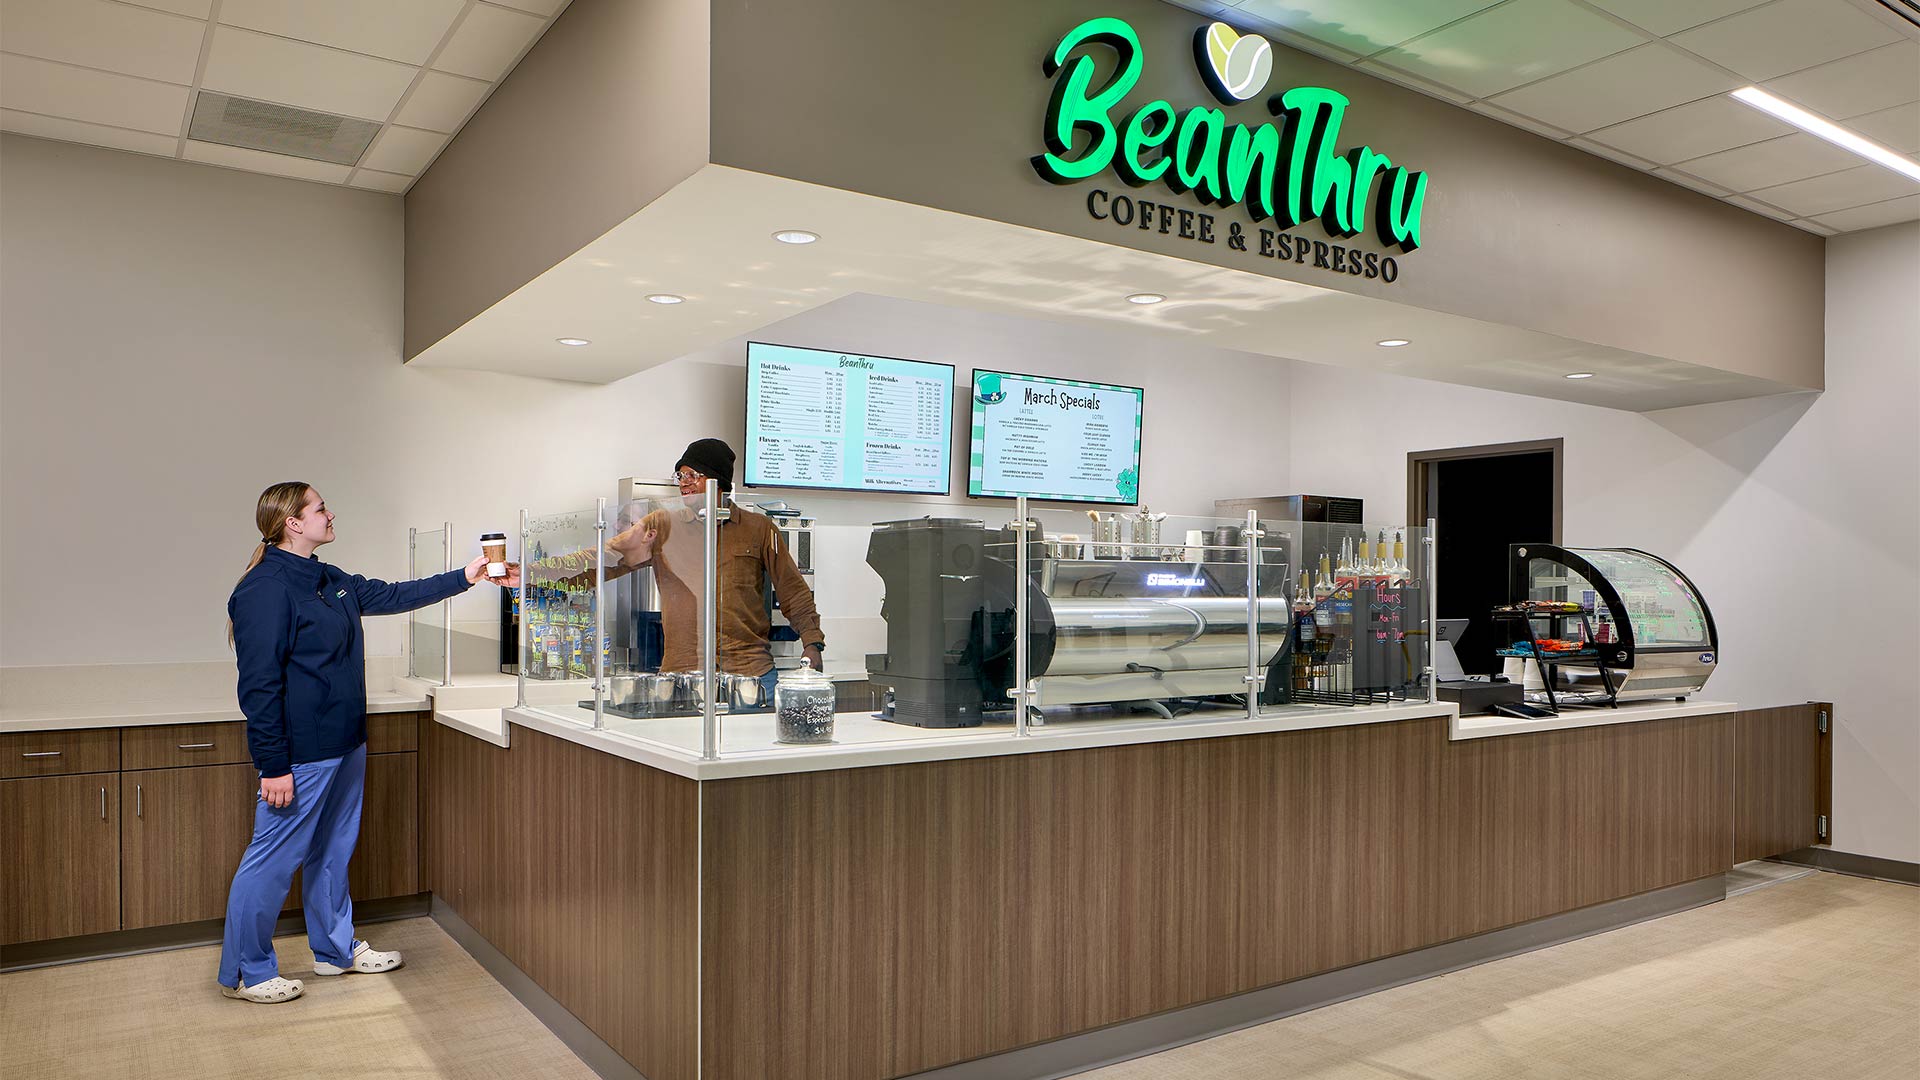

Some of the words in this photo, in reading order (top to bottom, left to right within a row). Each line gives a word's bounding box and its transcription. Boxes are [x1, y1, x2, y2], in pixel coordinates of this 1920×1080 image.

[1036, 17, 1428, 250] BeanThru
[1087, 188, 1215, 244] COFFEE
[1228, 221, 1247, 252] &
[1259, 228, 1398, 283] ESPRESSO
[839, 355, 874, 370] BeanThru
[1024, 388, 1057, 405] March
[1060, 392, 1100, 410] Specials
[1377, 588, 1400, 604] Hours
